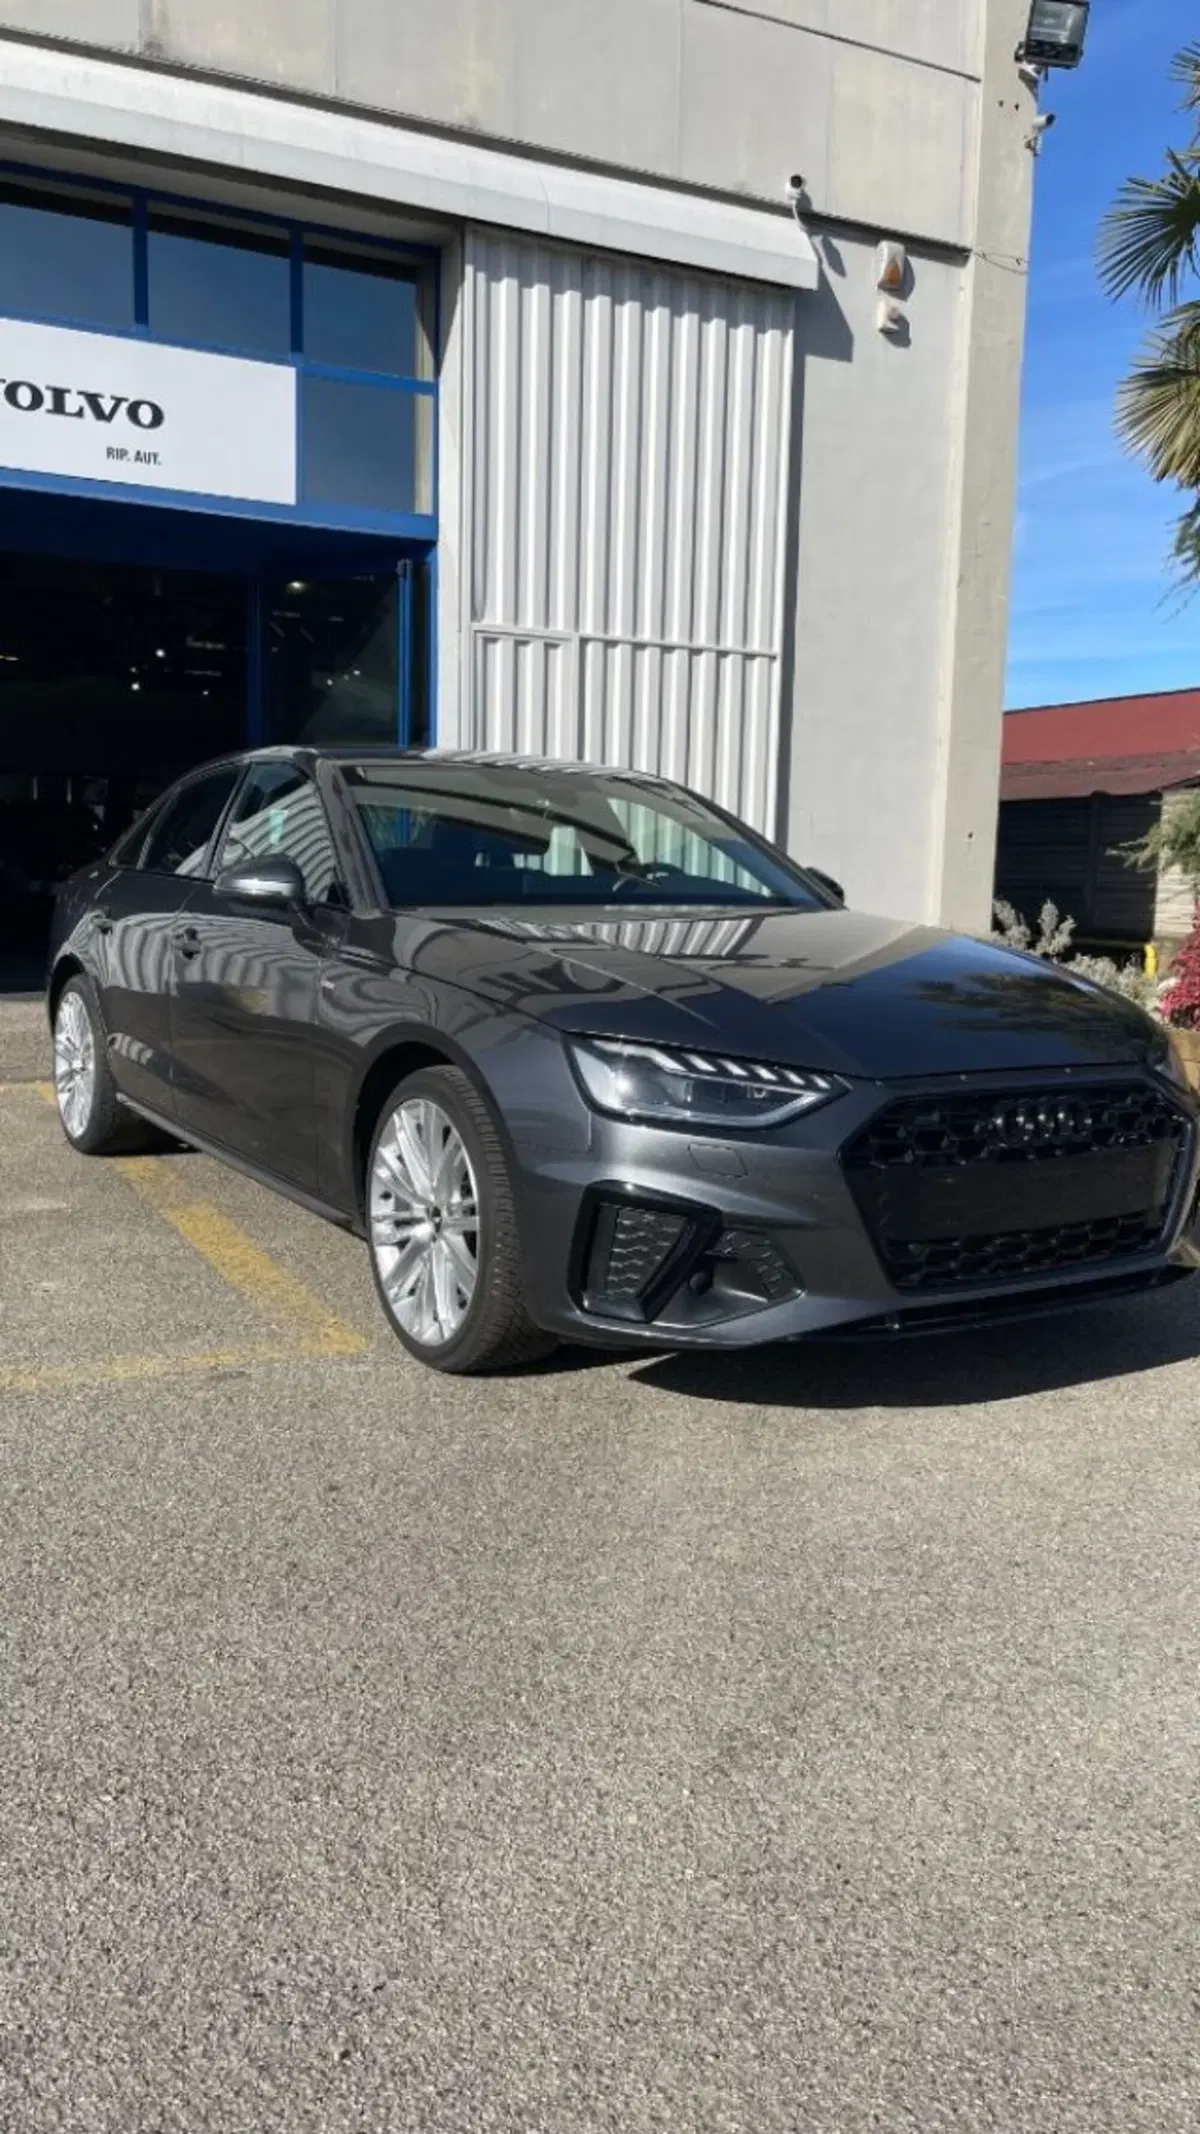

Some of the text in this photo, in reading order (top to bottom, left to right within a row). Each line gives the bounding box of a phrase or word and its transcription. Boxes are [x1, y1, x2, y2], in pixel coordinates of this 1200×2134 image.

[0, 378, 164, 430] OLVO
[106, 447, 162, 465] RIP. AUT.
